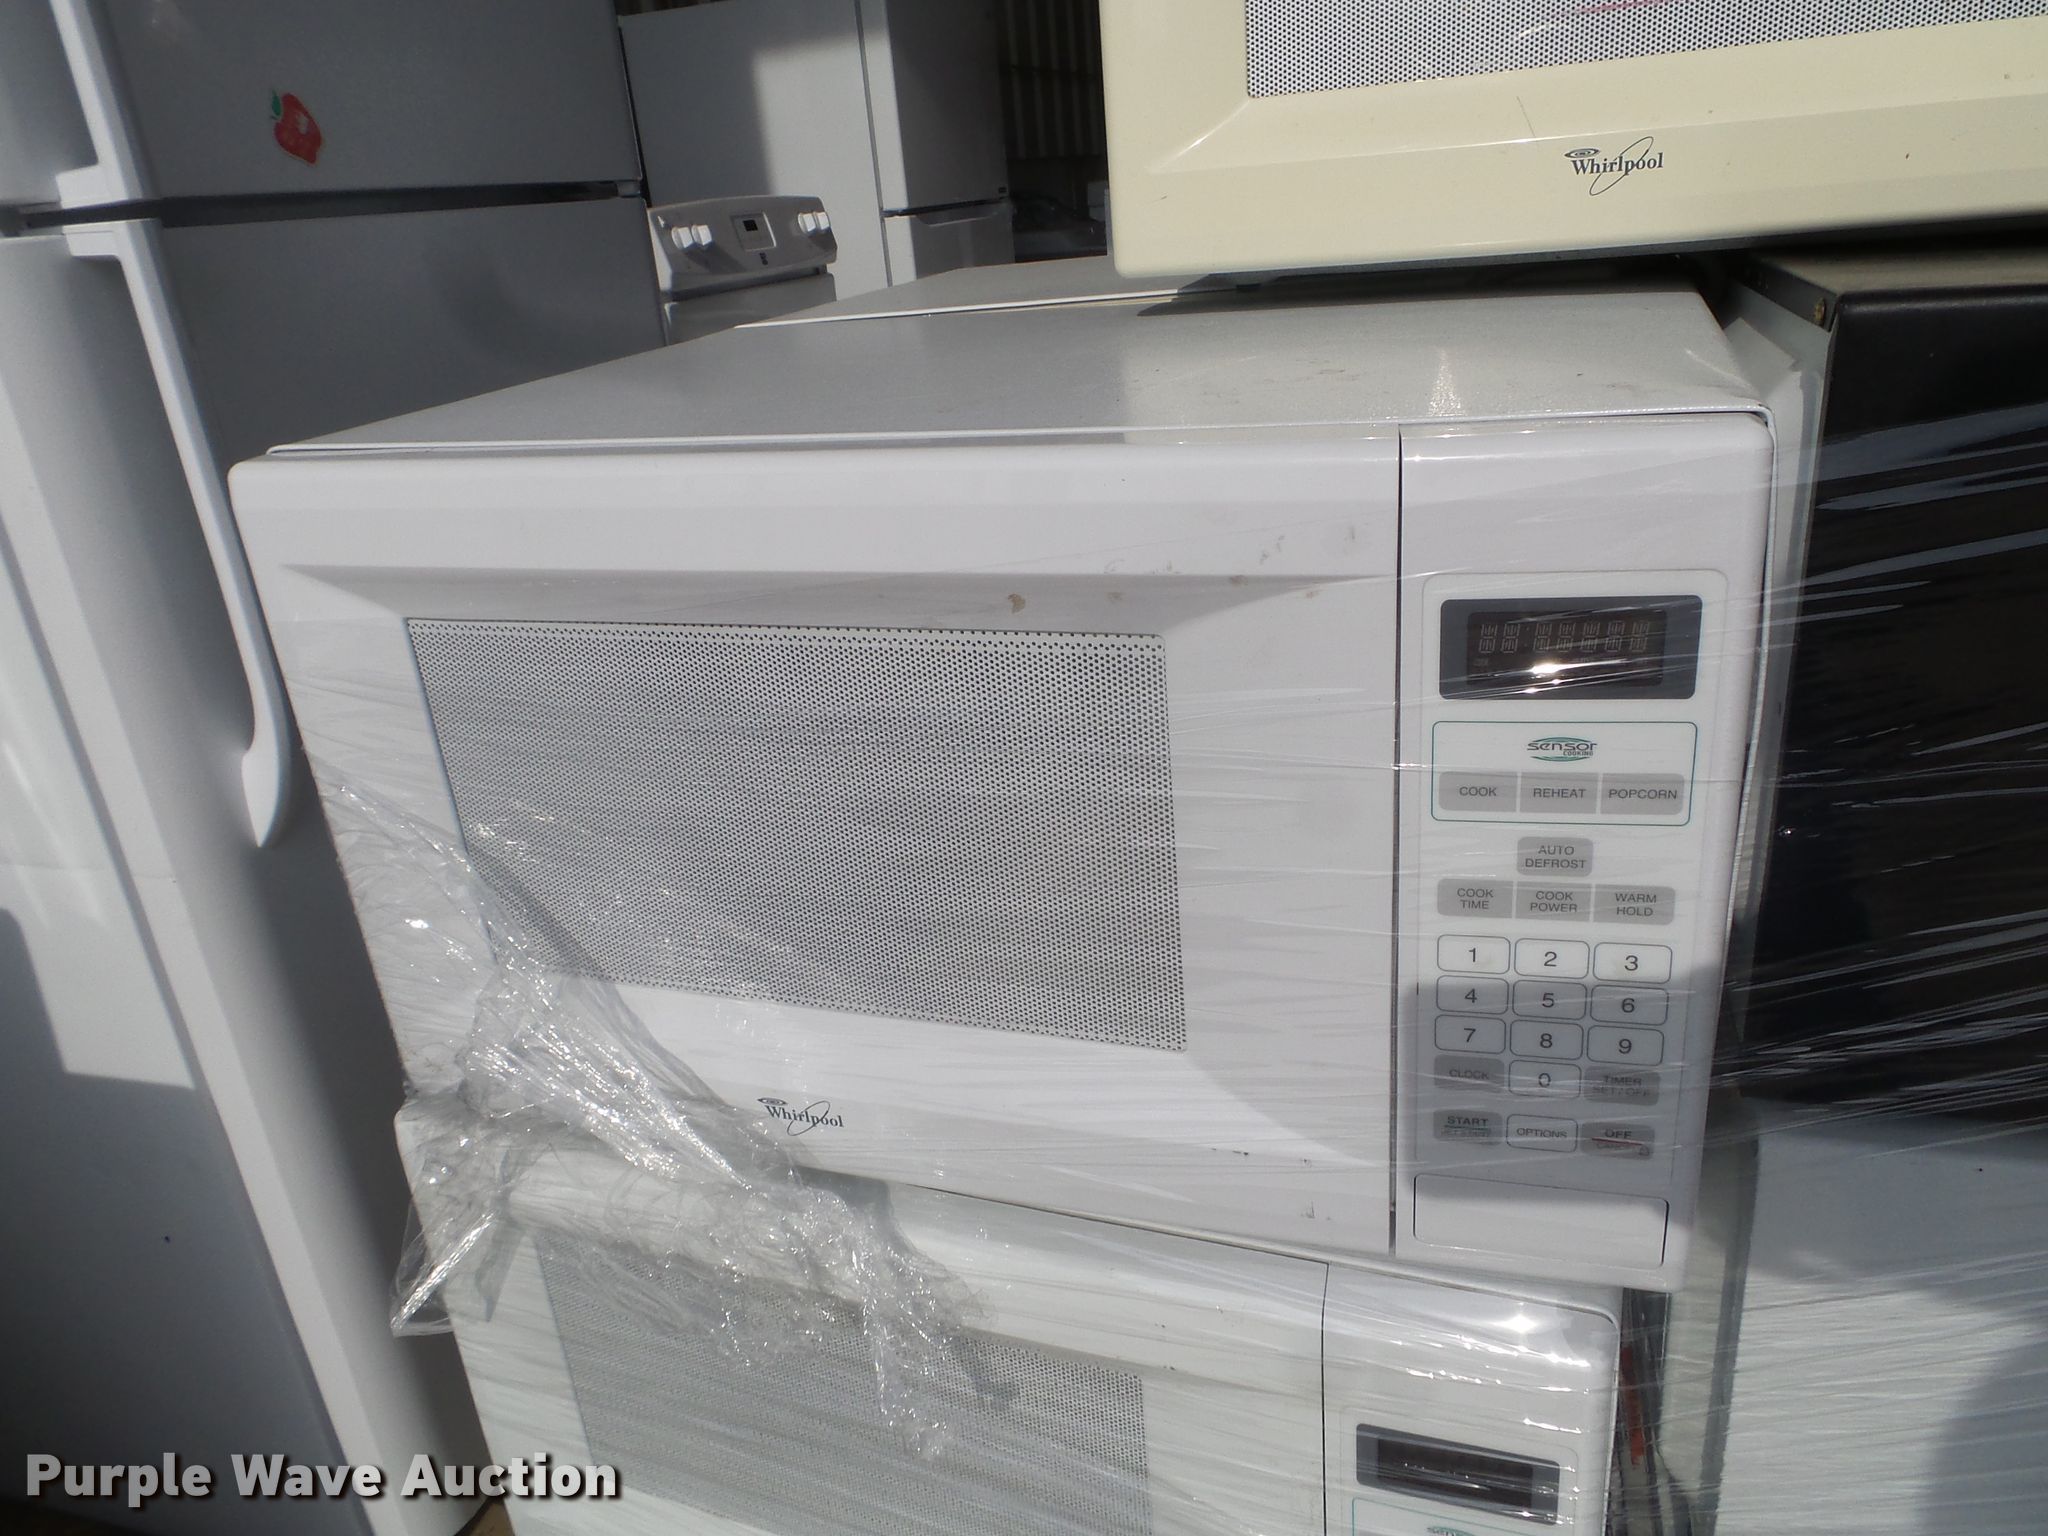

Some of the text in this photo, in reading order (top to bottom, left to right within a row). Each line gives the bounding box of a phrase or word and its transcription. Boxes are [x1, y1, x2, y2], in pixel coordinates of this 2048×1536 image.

[1570, 151, 1664, 176] Whirlpool
[1459, 786, 1497, 797] COOK
[1533, 787, 1587, 799] REHEAT
[1608, 788, 1678, 800] POPCORN
[1538, 845, 1575, 856] AUTO
[1525, 858, 1587, 870] DEFROST
[1457, 887, 1494, 899] COOK
[1535, 890, 1573, 902] COOK
[1615, 892, 1657, 904] WARM
[1460, 899, 1490, 910] TIME
[1530, 902, 1578, 913] POWER
[1616, 906, 1654, 917] HOLD
[1468, 947, 1477, 963] 1
[1543, 951, 1558, 967] 2
[1624, 955, 1639, 971] 3
[1464, 988, 1478, 1004] 4
[1541, 992, 1555, 1008] 5
[1621, 997, 1635, 1013] 6
[1463, 1027, 1476, 1043] 7
[1539, 1033, 1553, 1049] 8
[1618, 1038, 1632, 1054] 9
[1448, 1069, 1490, 1081] CLOCK
[1538, 1072, 1552, 1088] 0
[1603, 1074, 1642, 1086] TIMER
[764, 1104, 845, 1128] Whirlpool
[1447, 1115, 1489, 1127] START
[1516, 1127, 1568, 1138] OPTIONS
[1604, 1128, 1633, 1139] OFF
